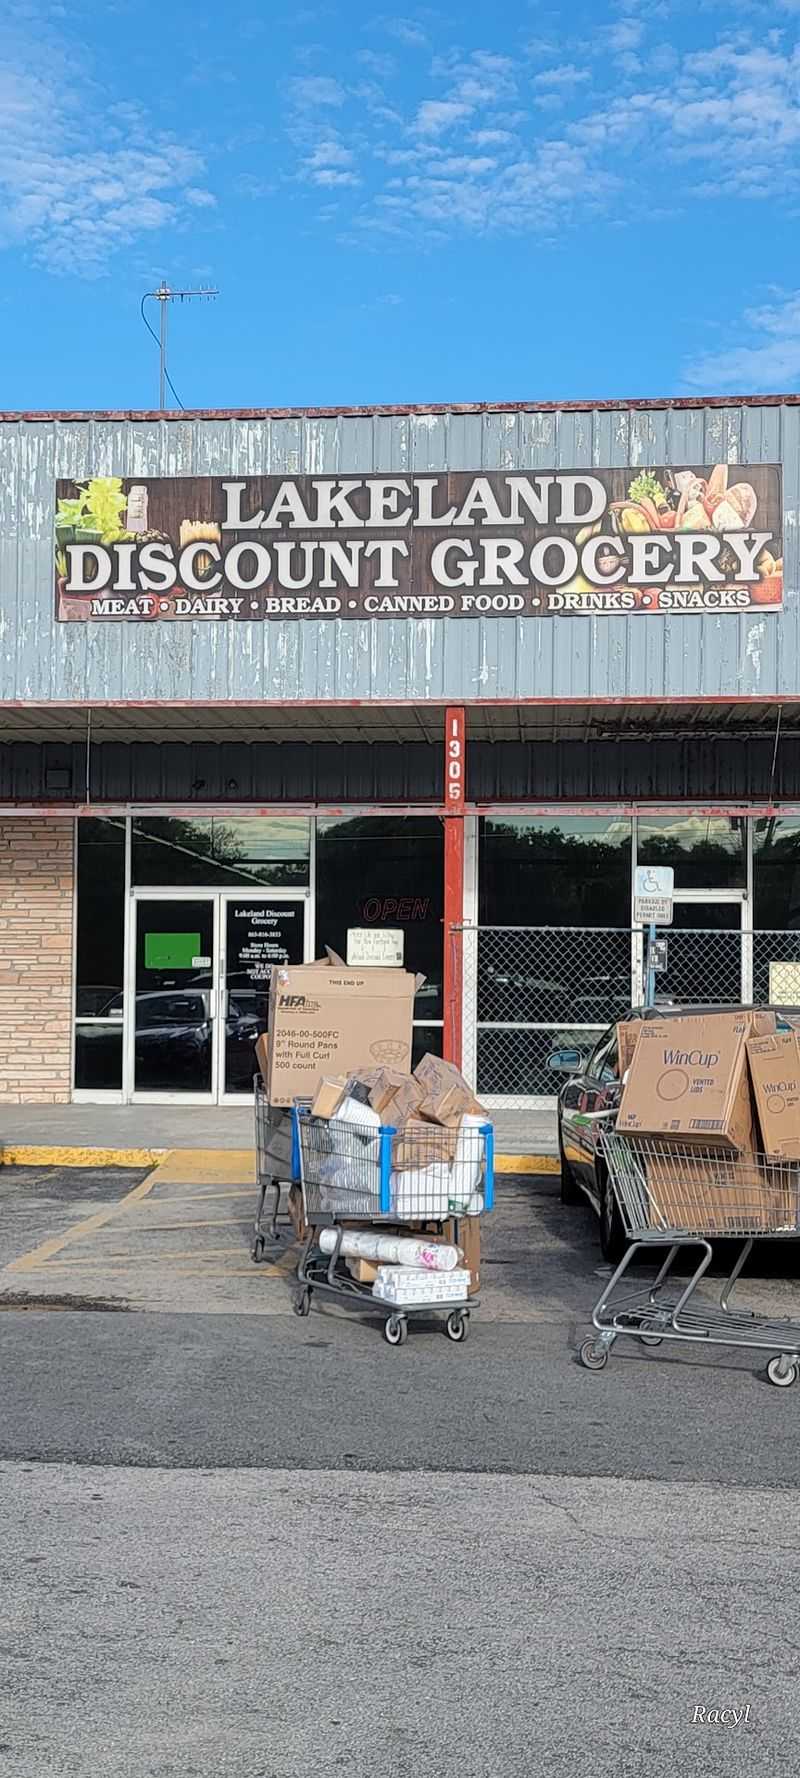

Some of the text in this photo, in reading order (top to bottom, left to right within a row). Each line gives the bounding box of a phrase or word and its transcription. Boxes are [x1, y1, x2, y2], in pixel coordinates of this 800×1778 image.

[221, 475, 608, 530] LAKELAND
[65, 531, 773, 592] DISCOUNT GROCERY
[91, 590, 751, 616] MEAT DAIRY BREAD CANNED FOOD DRINKS SNACKS
[448, 719, 461, 800] 1305
[234, 909, 295, 918] Lakeland Discount
[363, 898, 430, 921] OPEN
[251, 917, 278, 926] Grocery
[280, 995, 306, 1007] HFA
[288, 1040, 315, 1049] Round
[317, 1041, 338, 1049] Pans
[295, 1051, 311, 1059] Full
[312, 1051, 330, 1060] Curl
[663, 1049, 720, 1068] WinCup
[275, 1061, 316, 1070] 500 count
[762, 1081, 796, 1094] WinCup
